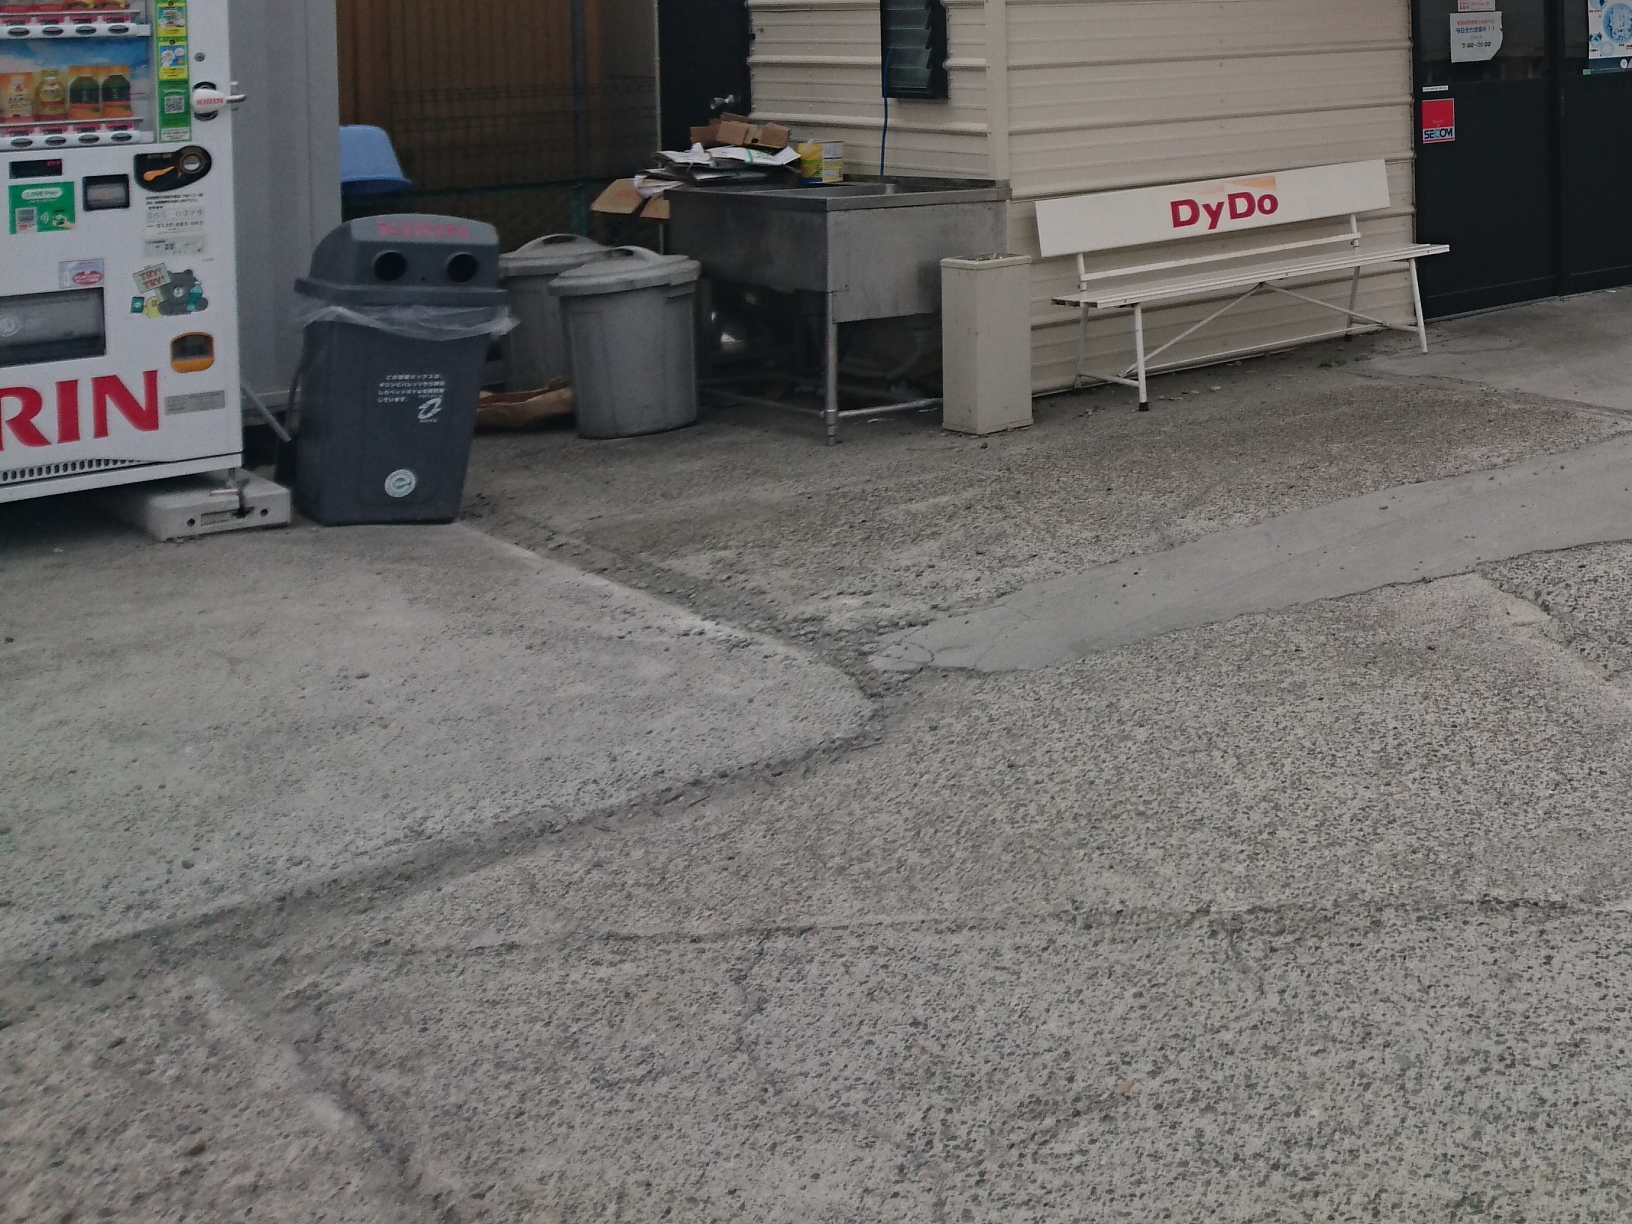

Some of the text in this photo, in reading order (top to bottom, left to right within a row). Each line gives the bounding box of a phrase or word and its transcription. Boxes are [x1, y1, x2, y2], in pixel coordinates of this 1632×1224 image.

[196, 97, 224, 106] KIRIN
[1424, 127, 1453, 140] SECOM
[1170, 191, 1279, 231] DyDo
[378, 221, 470, 240] KIRIN
